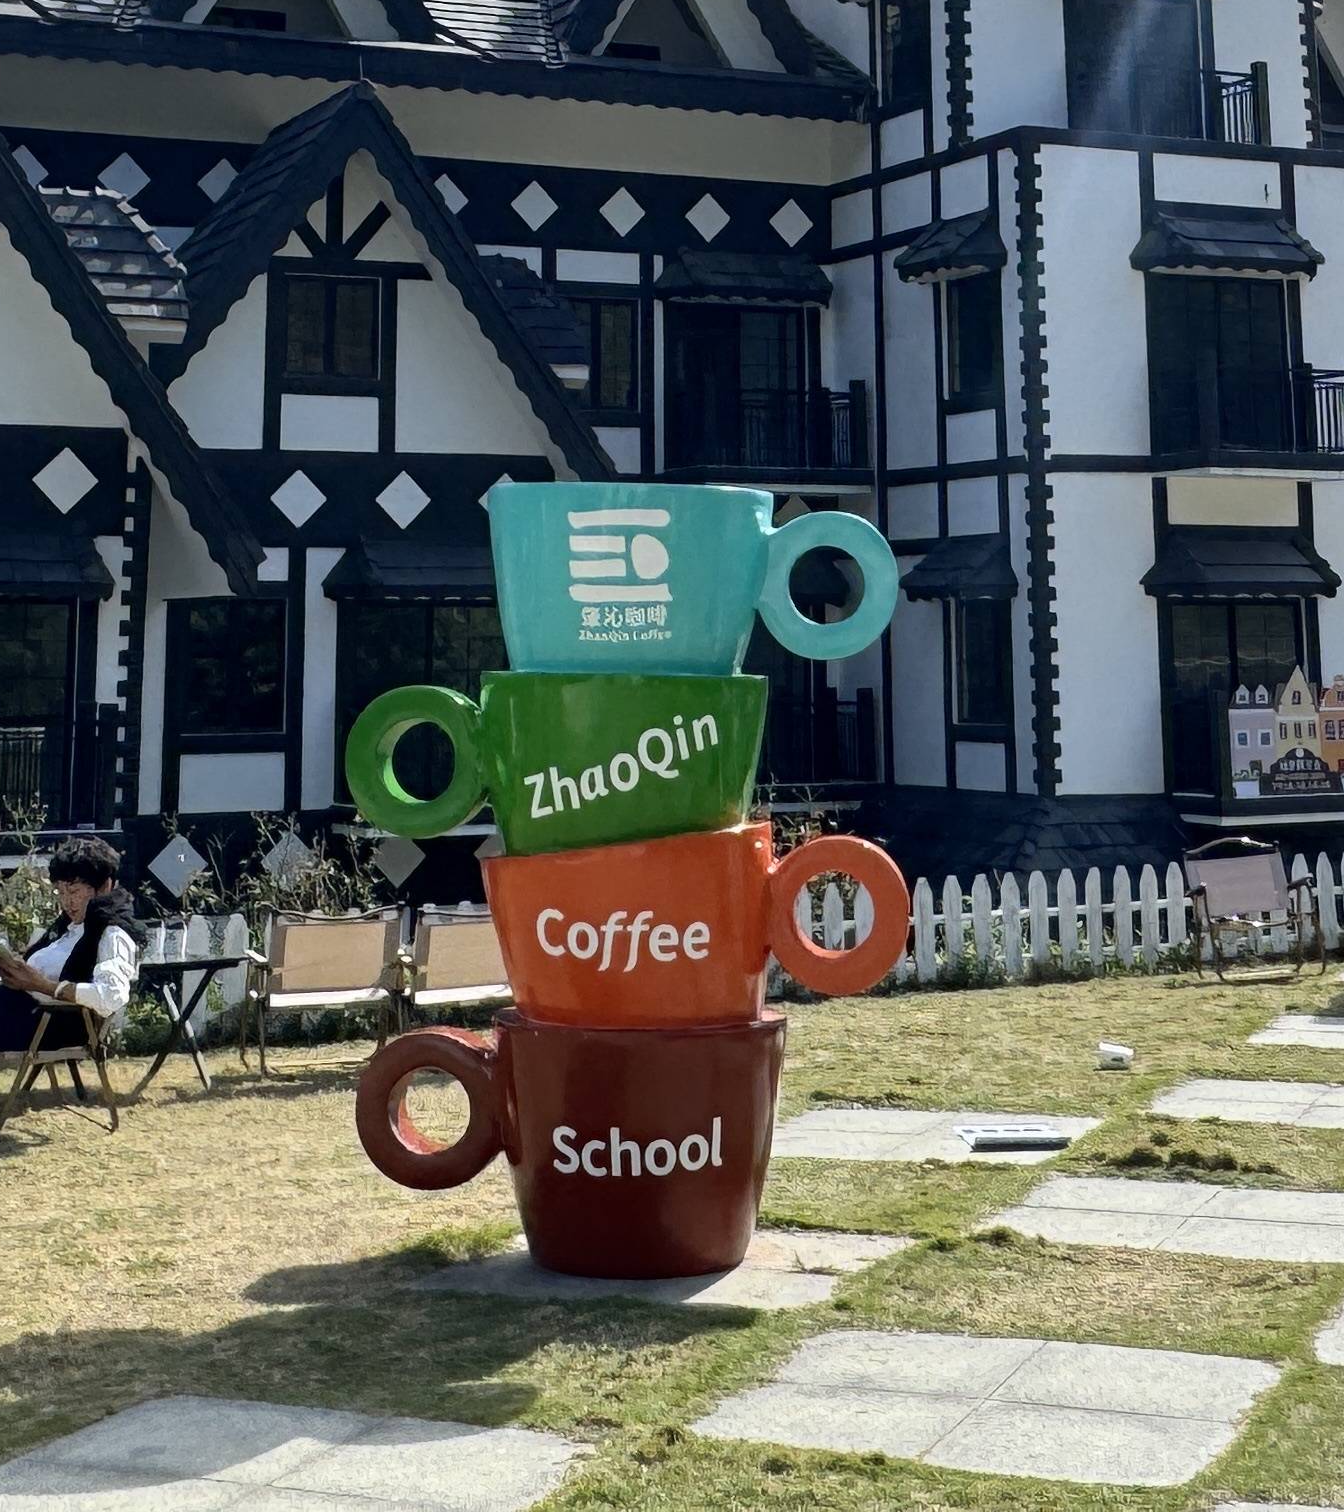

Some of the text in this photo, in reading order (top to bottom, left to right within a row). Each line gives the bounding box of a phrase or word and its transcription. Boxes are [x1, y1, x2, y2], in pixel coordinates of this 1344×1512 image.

[523, 714, 719, 819] ZhaoQin
[535, 908, 711, 973] Coffee
[552, 1116, 723, 1178] School
